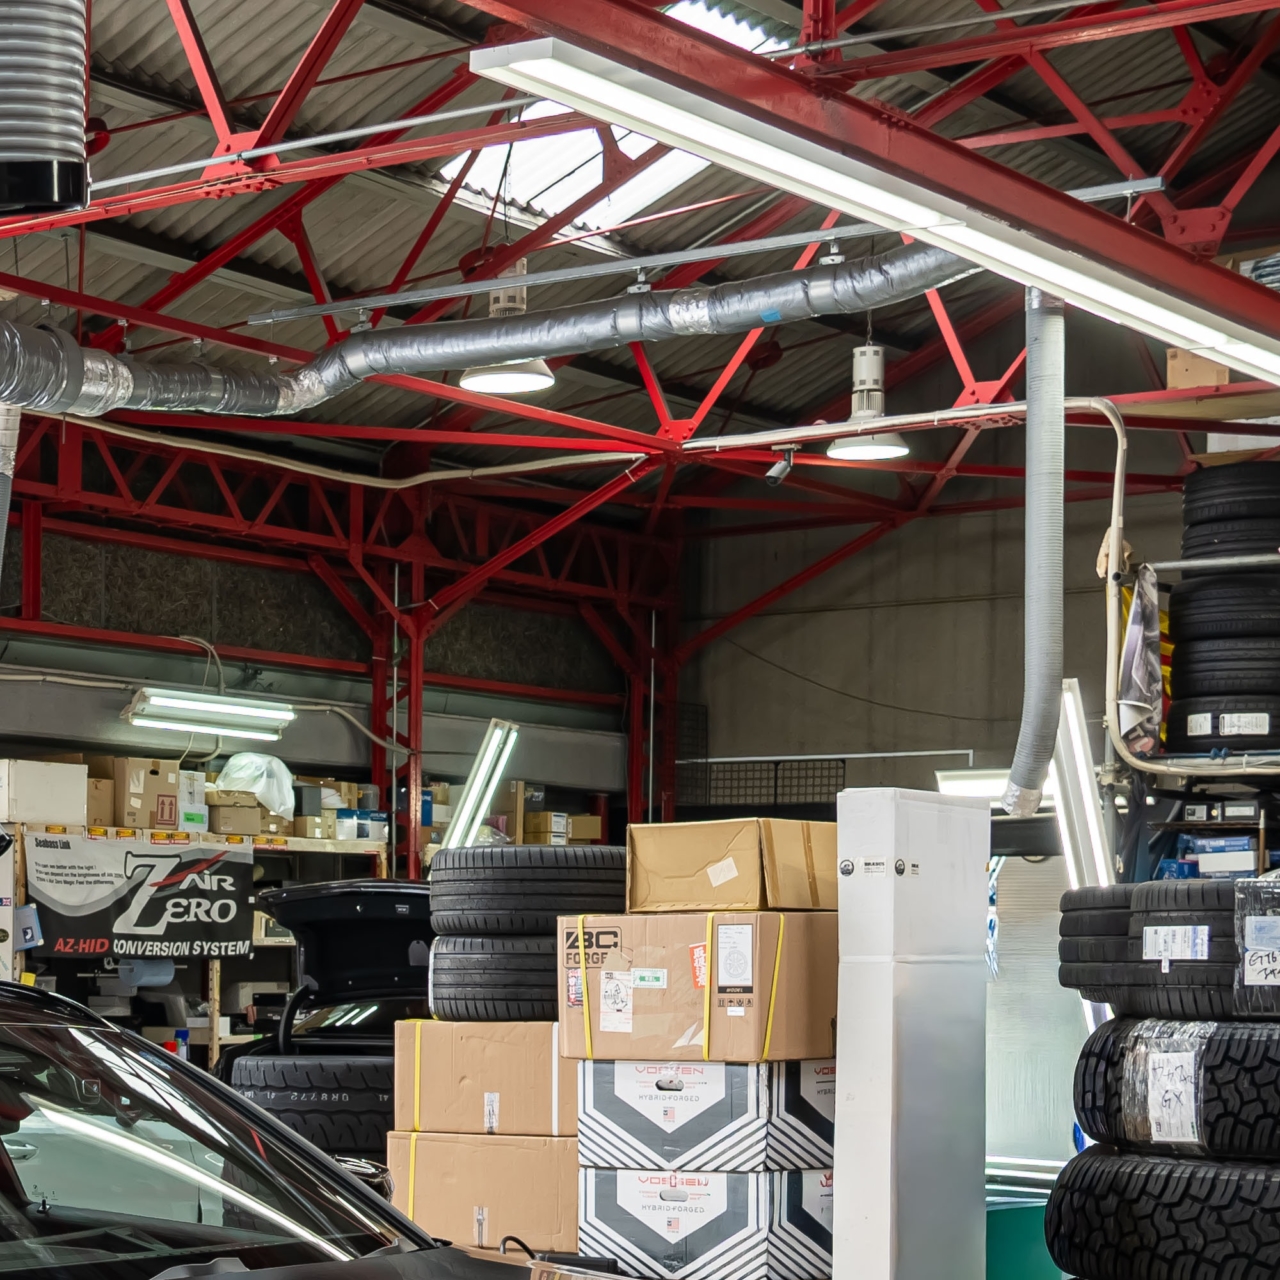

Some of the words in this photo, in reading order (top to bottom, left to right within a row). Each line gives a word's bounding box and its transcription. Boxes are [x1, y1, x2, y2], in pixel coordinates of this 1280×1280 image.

[35, 838, 59, 849] Seabass
[60, 840, 71, 849] Link
[54, 938, 109, 953] AZ-HID
[113, 939, 190, 956] CONVERSION
[566, 952, 609, 964] FORGE
[635, 1066, 704, 1075] VOEN
[814, 1067, 836, 1075] VOS
[637, 1176, 710, 1187] VOEN
